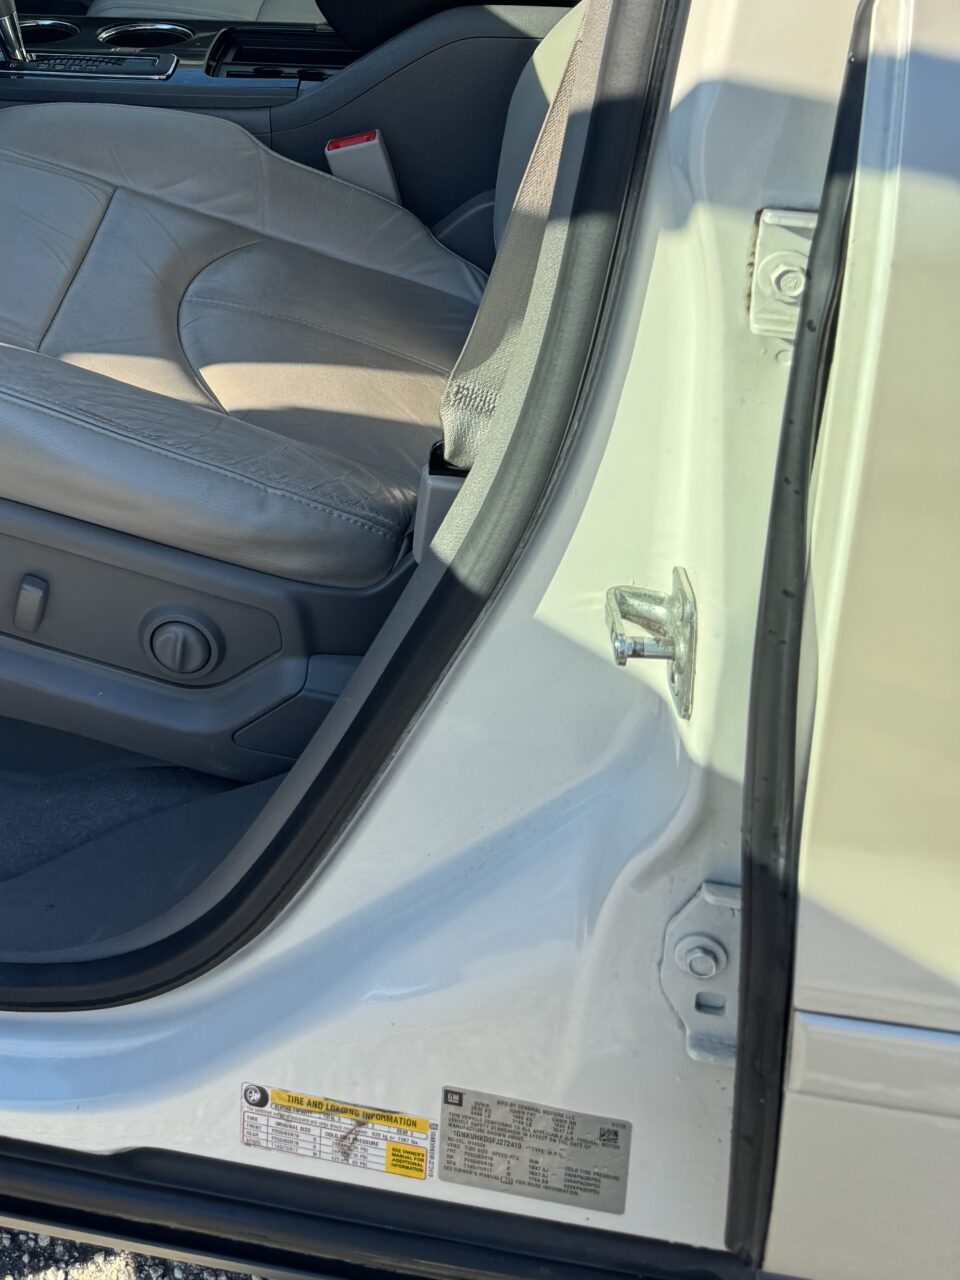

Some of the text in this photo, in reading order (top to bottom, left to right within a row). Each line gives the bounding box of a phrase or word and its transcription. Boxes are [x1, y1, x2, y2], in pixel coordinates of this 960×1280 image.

[448, 1093, 459, 1102] GM
[287, 1095, 304, 1106] TIRE
[307, 1099, 323, 1110] AND
[326, 1103, 360, 1117] LOADING
[363, 1110, 417, 1128] INFORMATION
